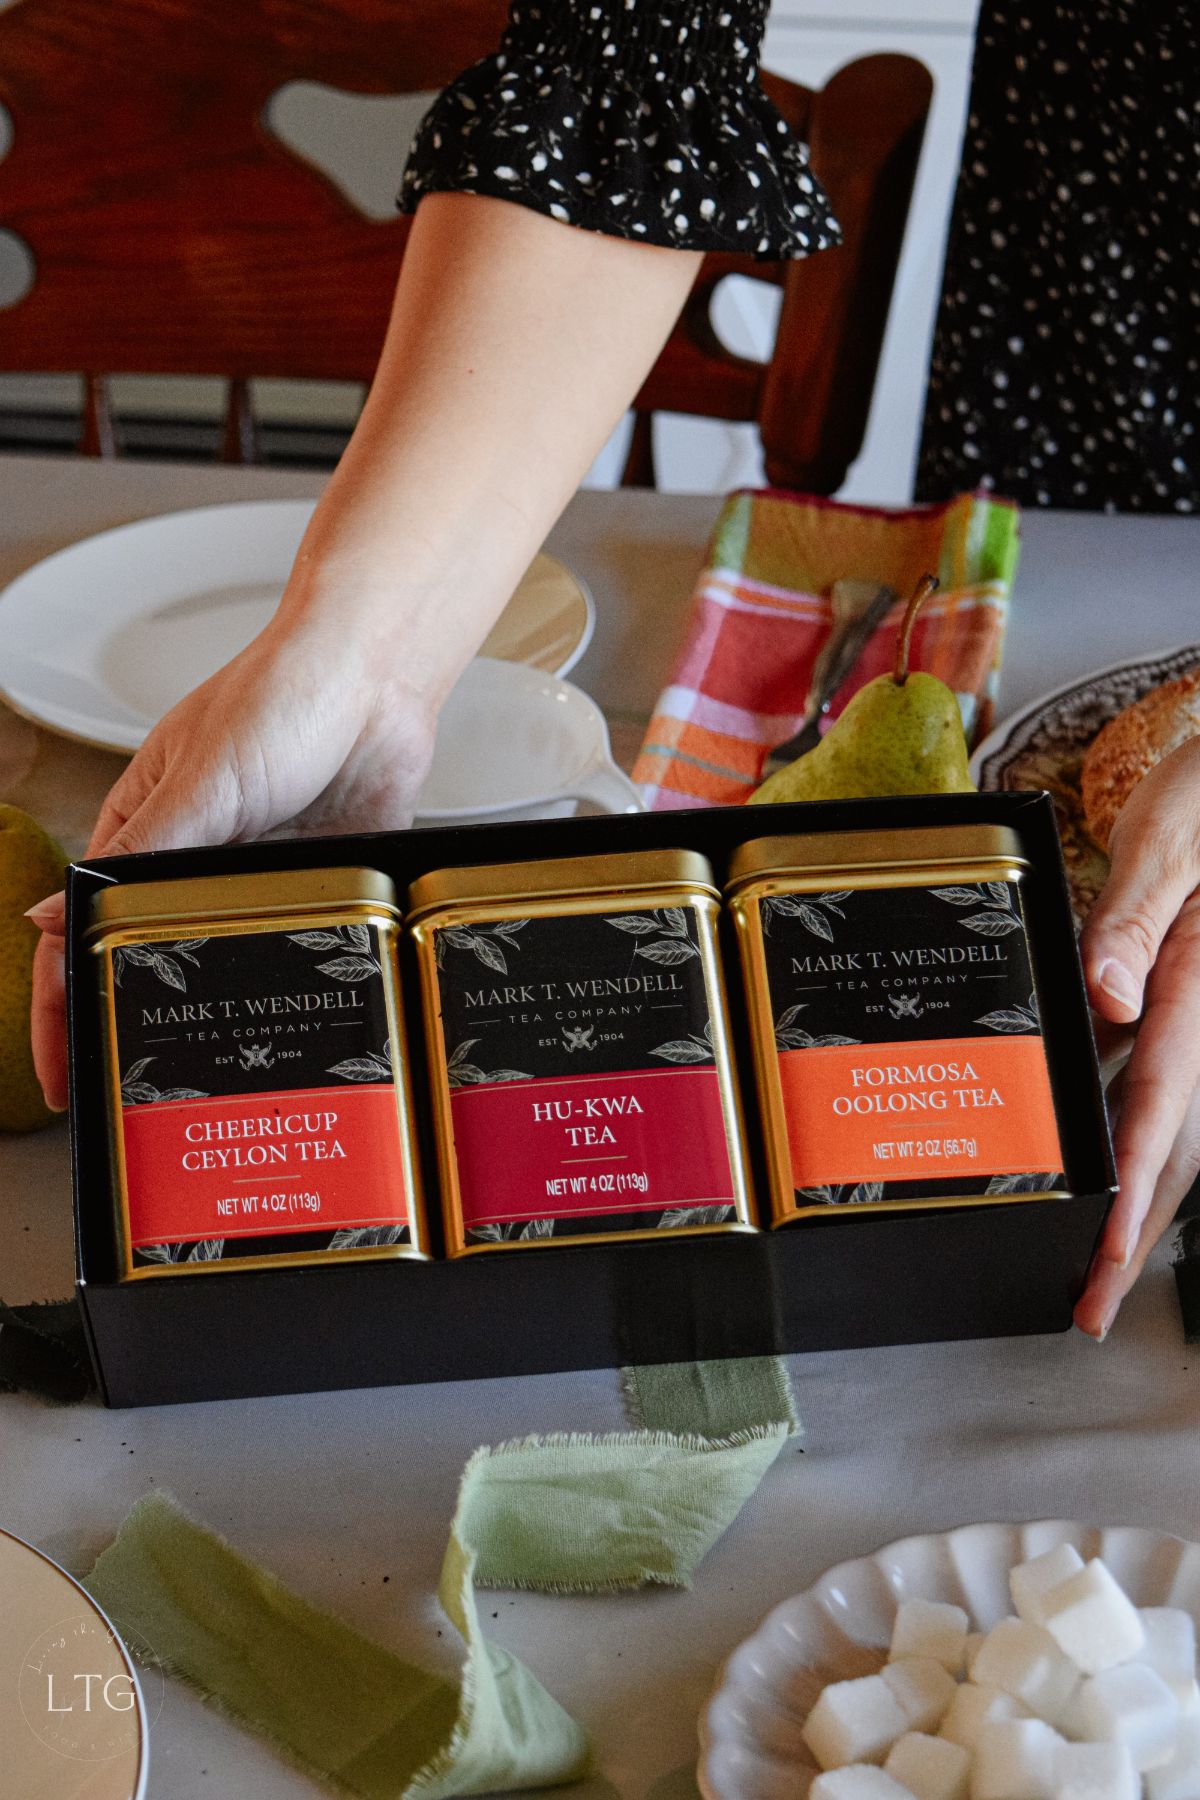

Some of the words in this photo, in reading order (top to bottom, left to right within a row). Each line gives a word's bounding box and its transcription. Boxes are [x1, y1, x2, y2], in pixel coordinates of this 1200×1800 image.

[791, 953, 862, 974] MARK
[867, 951, 886, 968] T.
[892, 944, 1008, 966] WENDELL
[465, 985, 536, 1008] MARK
[541, 983, 560, 1000] T.
[565, 974, 683, 999] WENDELL
[836, 980, 869, 991] TEA
[881, 974, 969, 988] COMPANY
[142, 1001, 217, 1026] MARK
[220, 1000, 239, 1018] T.
[242, 990, 364, 1016] WENDELL
[508, 1013, 542, 1024] TEA
[555, 1005, 643, 1021] COMPANY
[865, 1005, 884, 1013] EST
[925, 1001, 950, 1009] 1904
[186, 1032, 221, 1041] TEA
[233, 1022, 323, 1038] COMPANY
[538, 1038, 557, 1046] EST
[599, 1032, 624, 1041] 1904
[215, 1056, 234, 1065] EST
[276, 1050, 303, 1059] 1904
[851, 1062, 979, 1087] FORMOSA
[532, 1095, 645, 1122] HU-KWA
[832, 1090, 948, 1116] OOLONG
[953, 1087, 1004, 1108] TEA
[184, 1111, 339, 1143] CHEERICUP
[565, 1125, 617, 1147] TEA
[181, 1143, 288, 1171] CEYLON
[295, 1139, 347, 1161] TEA
[873, 1141, 896, 1160] NET
[897, 1141, 915, 1158] WT
[916, 1141, 924, 1156] 2
[925, 1140, 941, 1157] OZ
[943, 1138, 977, 1158] (56.7g)
[546, 1178, 567, 1196] NET
[569, 1177, 588, 1193] WT
[590, 1176, 598, 1192] 4
[599, 1174, 615, 1192] OZ
[616, 1171, 649, 1193] (113g)
[217, 1197, 240, 1216] NET
[241, 1196, 259, 1214] WT
[262, 1197, 269, 1212] 4
[271, 1195, 287, 1211] OZ
[288, 1192, 321, 1214] (113g)
